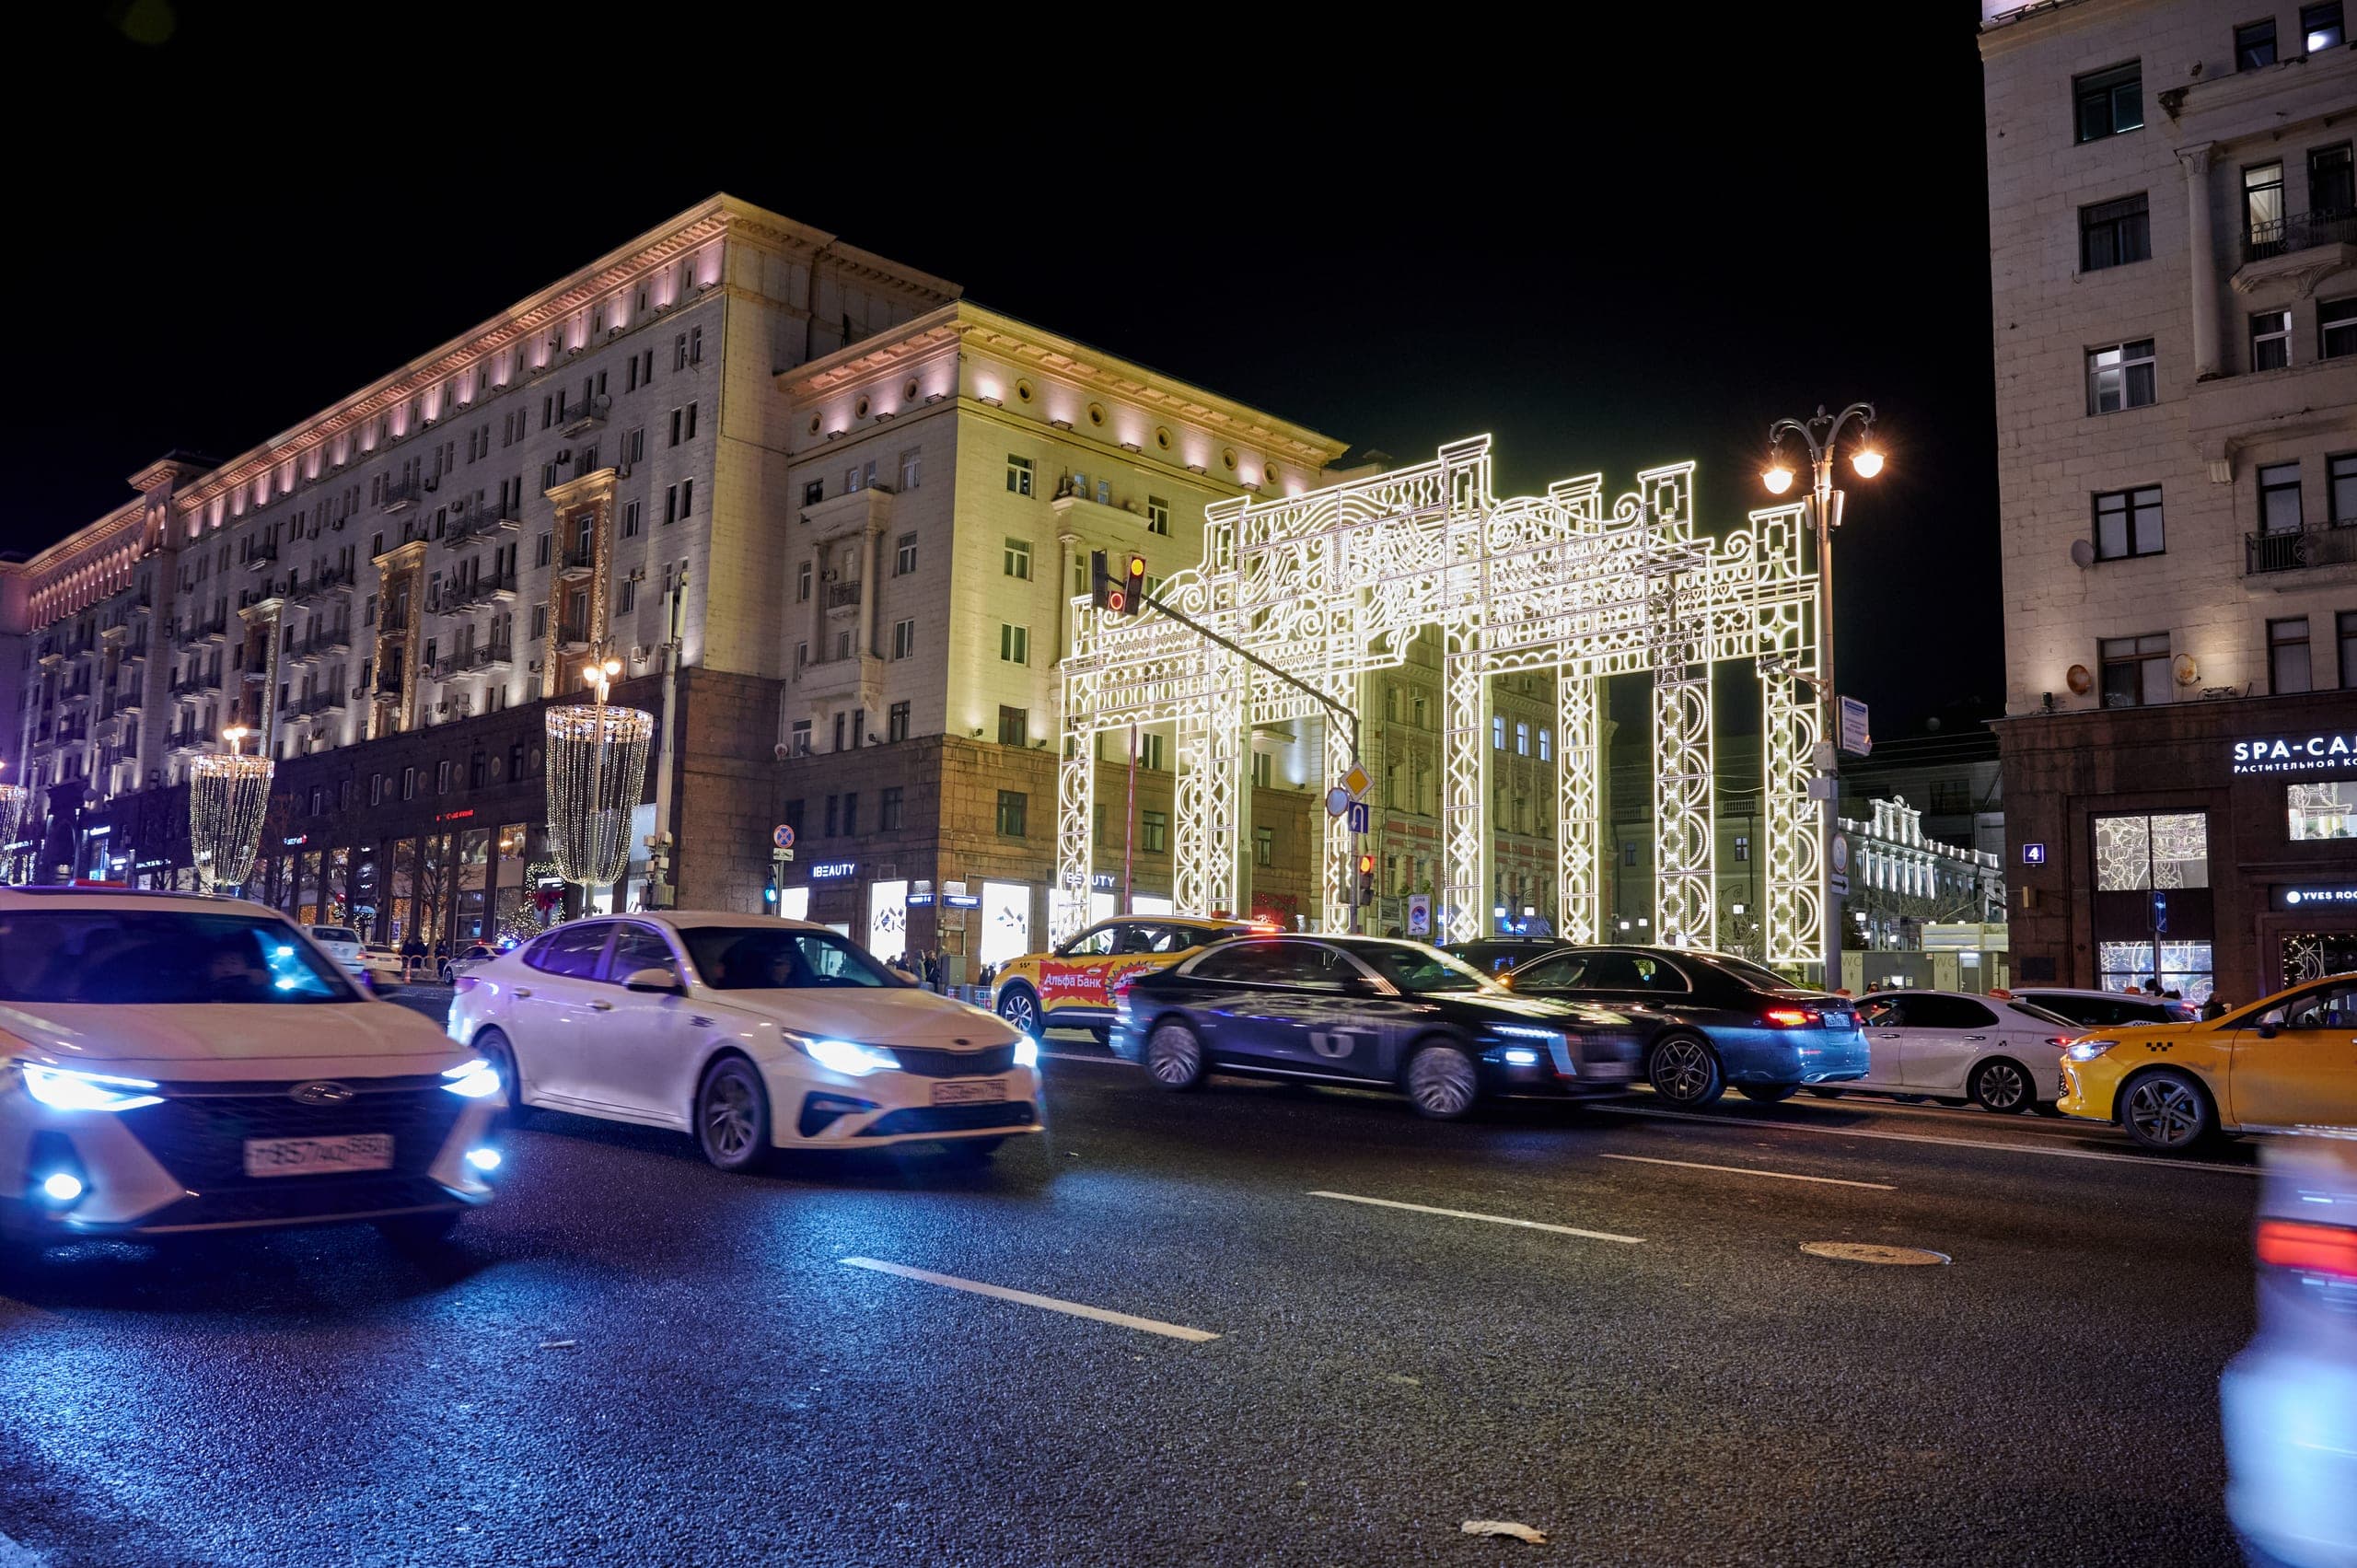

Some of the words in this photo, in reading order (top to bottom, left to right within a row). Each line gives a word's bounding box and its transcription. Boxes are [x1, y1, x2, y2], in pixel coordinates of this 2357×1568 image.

[2234, 736, 2357, 761] SPA-СА
[2234, 759, 2336, 773] РАСТИТЕЛЬНОЙ
[2028, 846, 2039, 860] 4
[2303, 891, 2332, 900] YVES
[1841, 956, 1863, 968] WC
[1935, 956, 1956, 968] WC
[1044, 973, 1075, 989] Альфа
[1076, 974, 1102, 988] Банк
